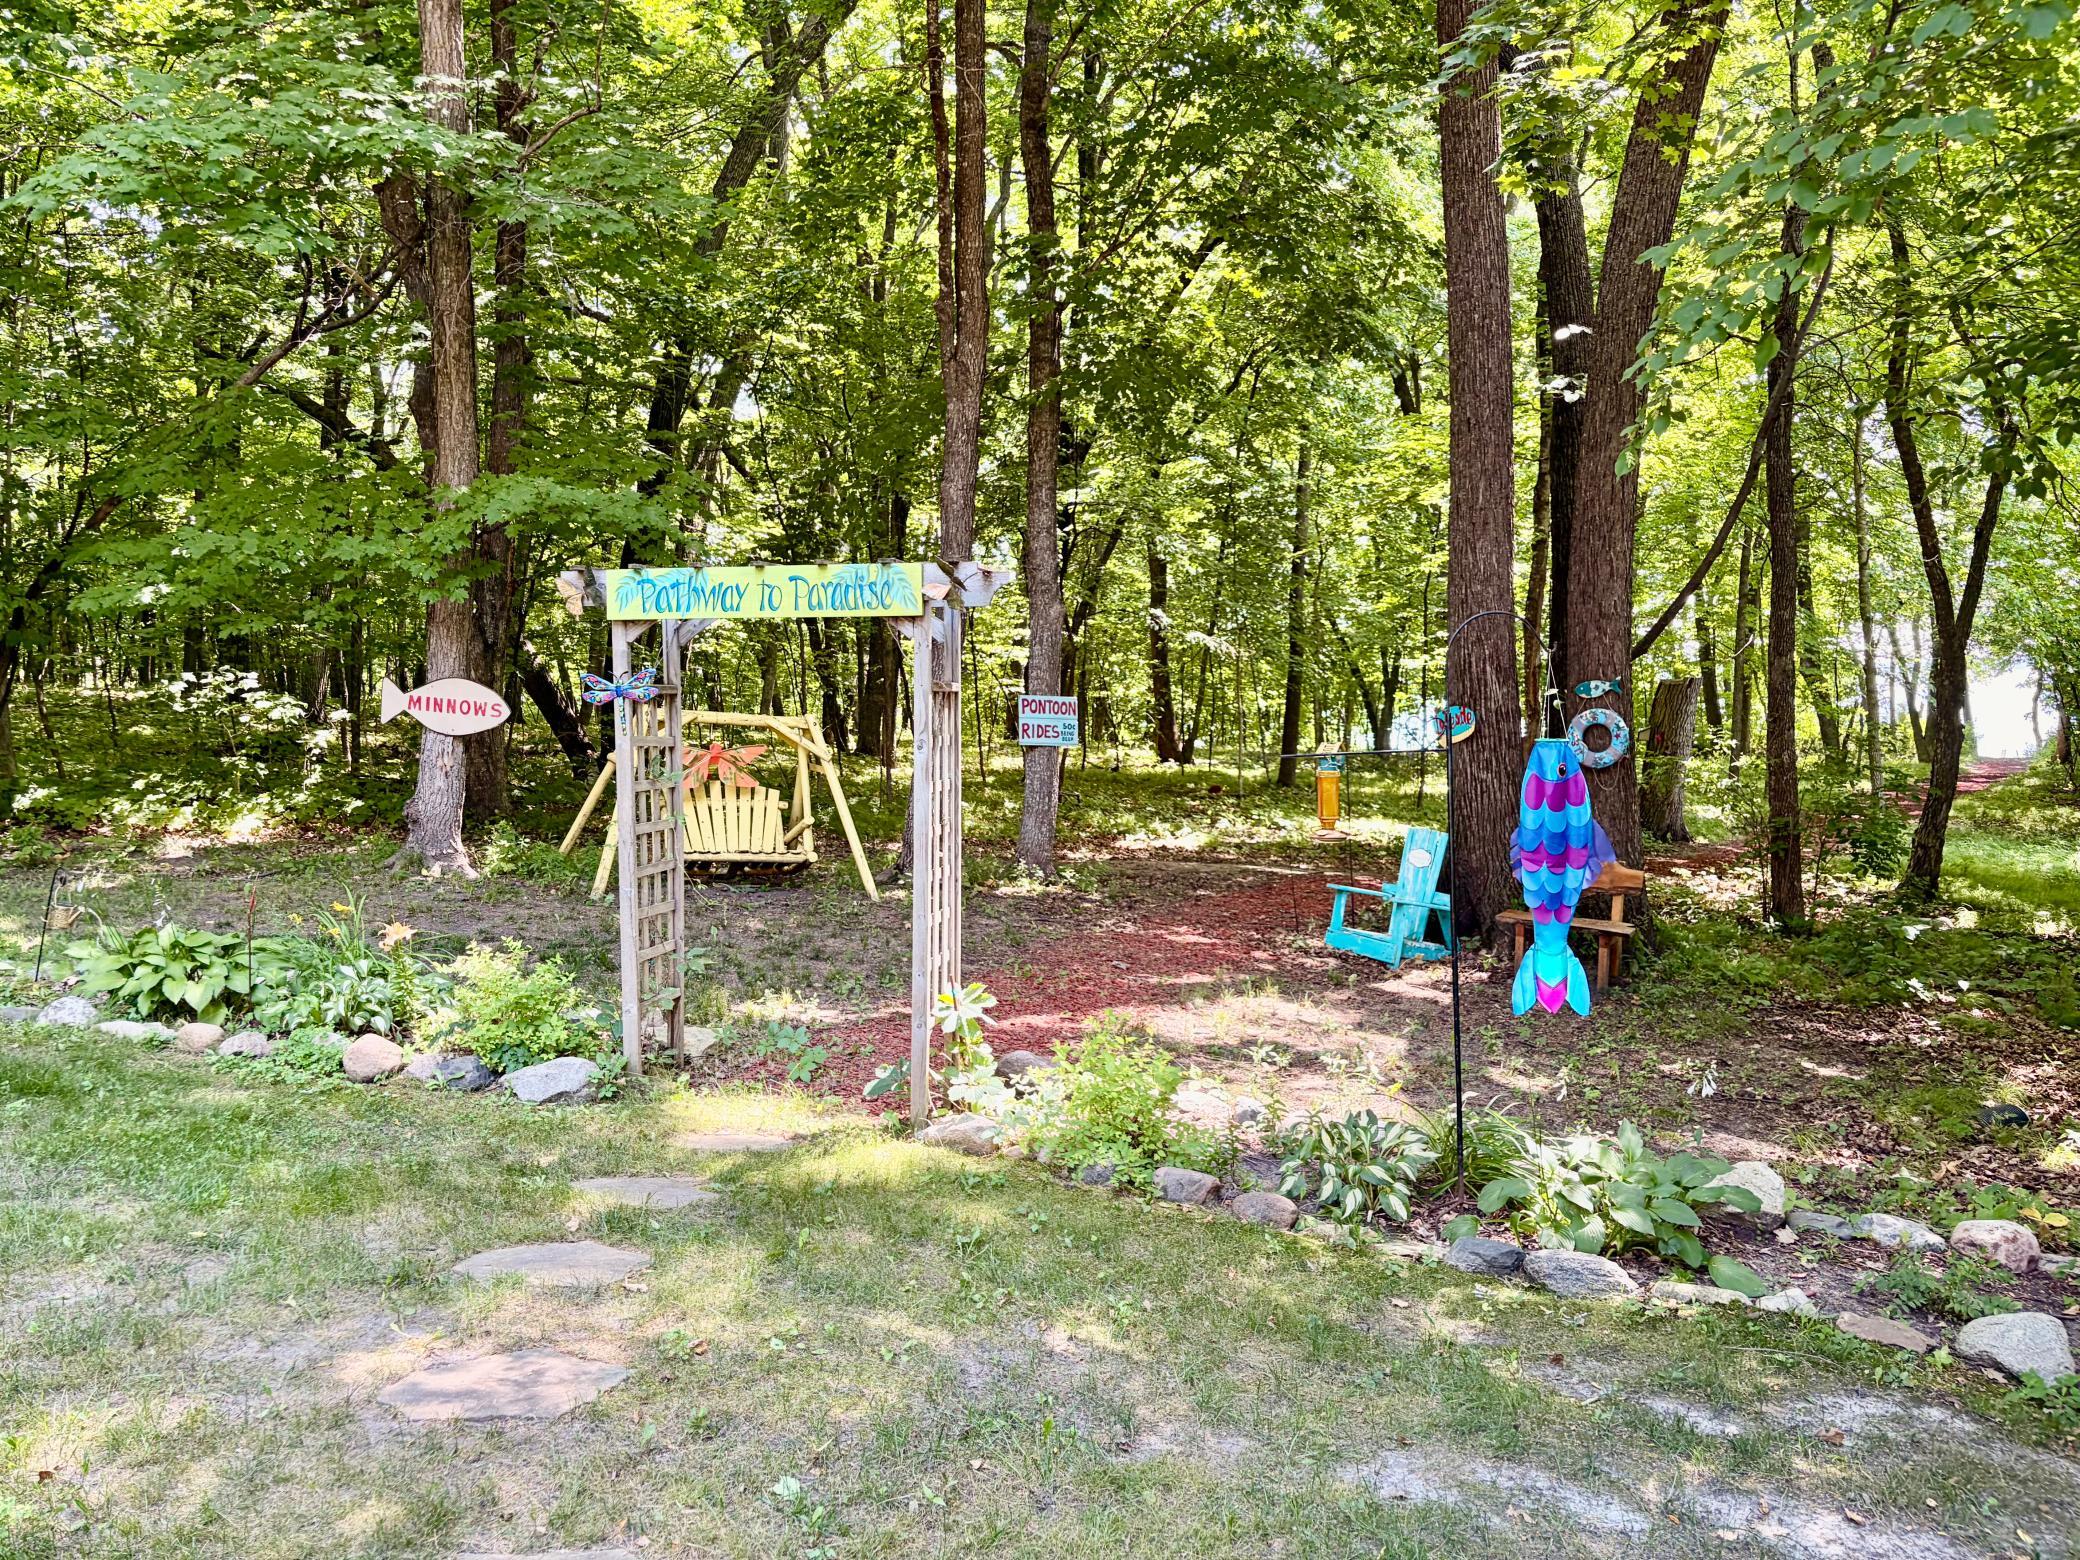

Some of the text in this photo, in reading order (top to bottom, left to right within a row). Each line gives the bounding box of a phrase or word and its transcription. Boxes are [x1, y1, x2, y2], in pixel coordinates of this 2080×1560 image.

[636, 571, 894, 614] Pathway to Paradise
[407, 694, 503, 718] MINNOWS
[1021, 698, 1077, 716] PONTOON
[1021, 722, 1060, 740] RIDES
